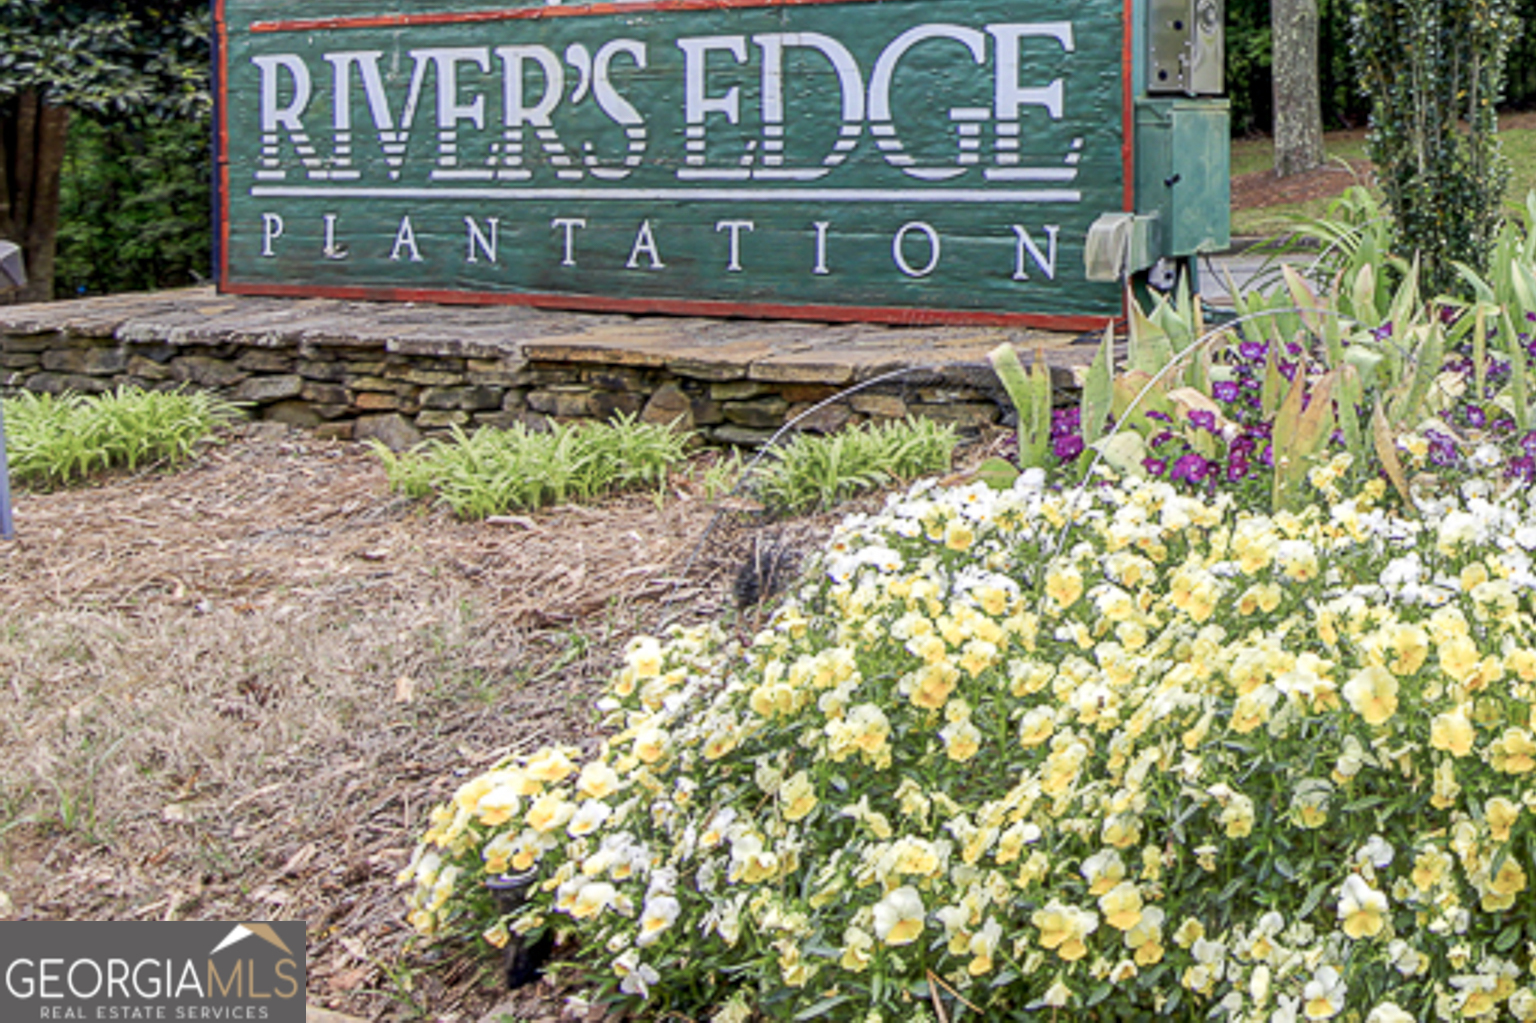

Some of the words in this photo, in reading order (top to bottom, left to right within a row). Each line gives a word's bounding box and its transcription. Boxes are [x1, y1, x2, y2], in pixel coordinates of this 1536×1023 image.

[251, 38, 647, 180] RIVER'S
[676, 21, 1083, 181] EDGE
[261, 212, 1060, 282] PLANTATION
